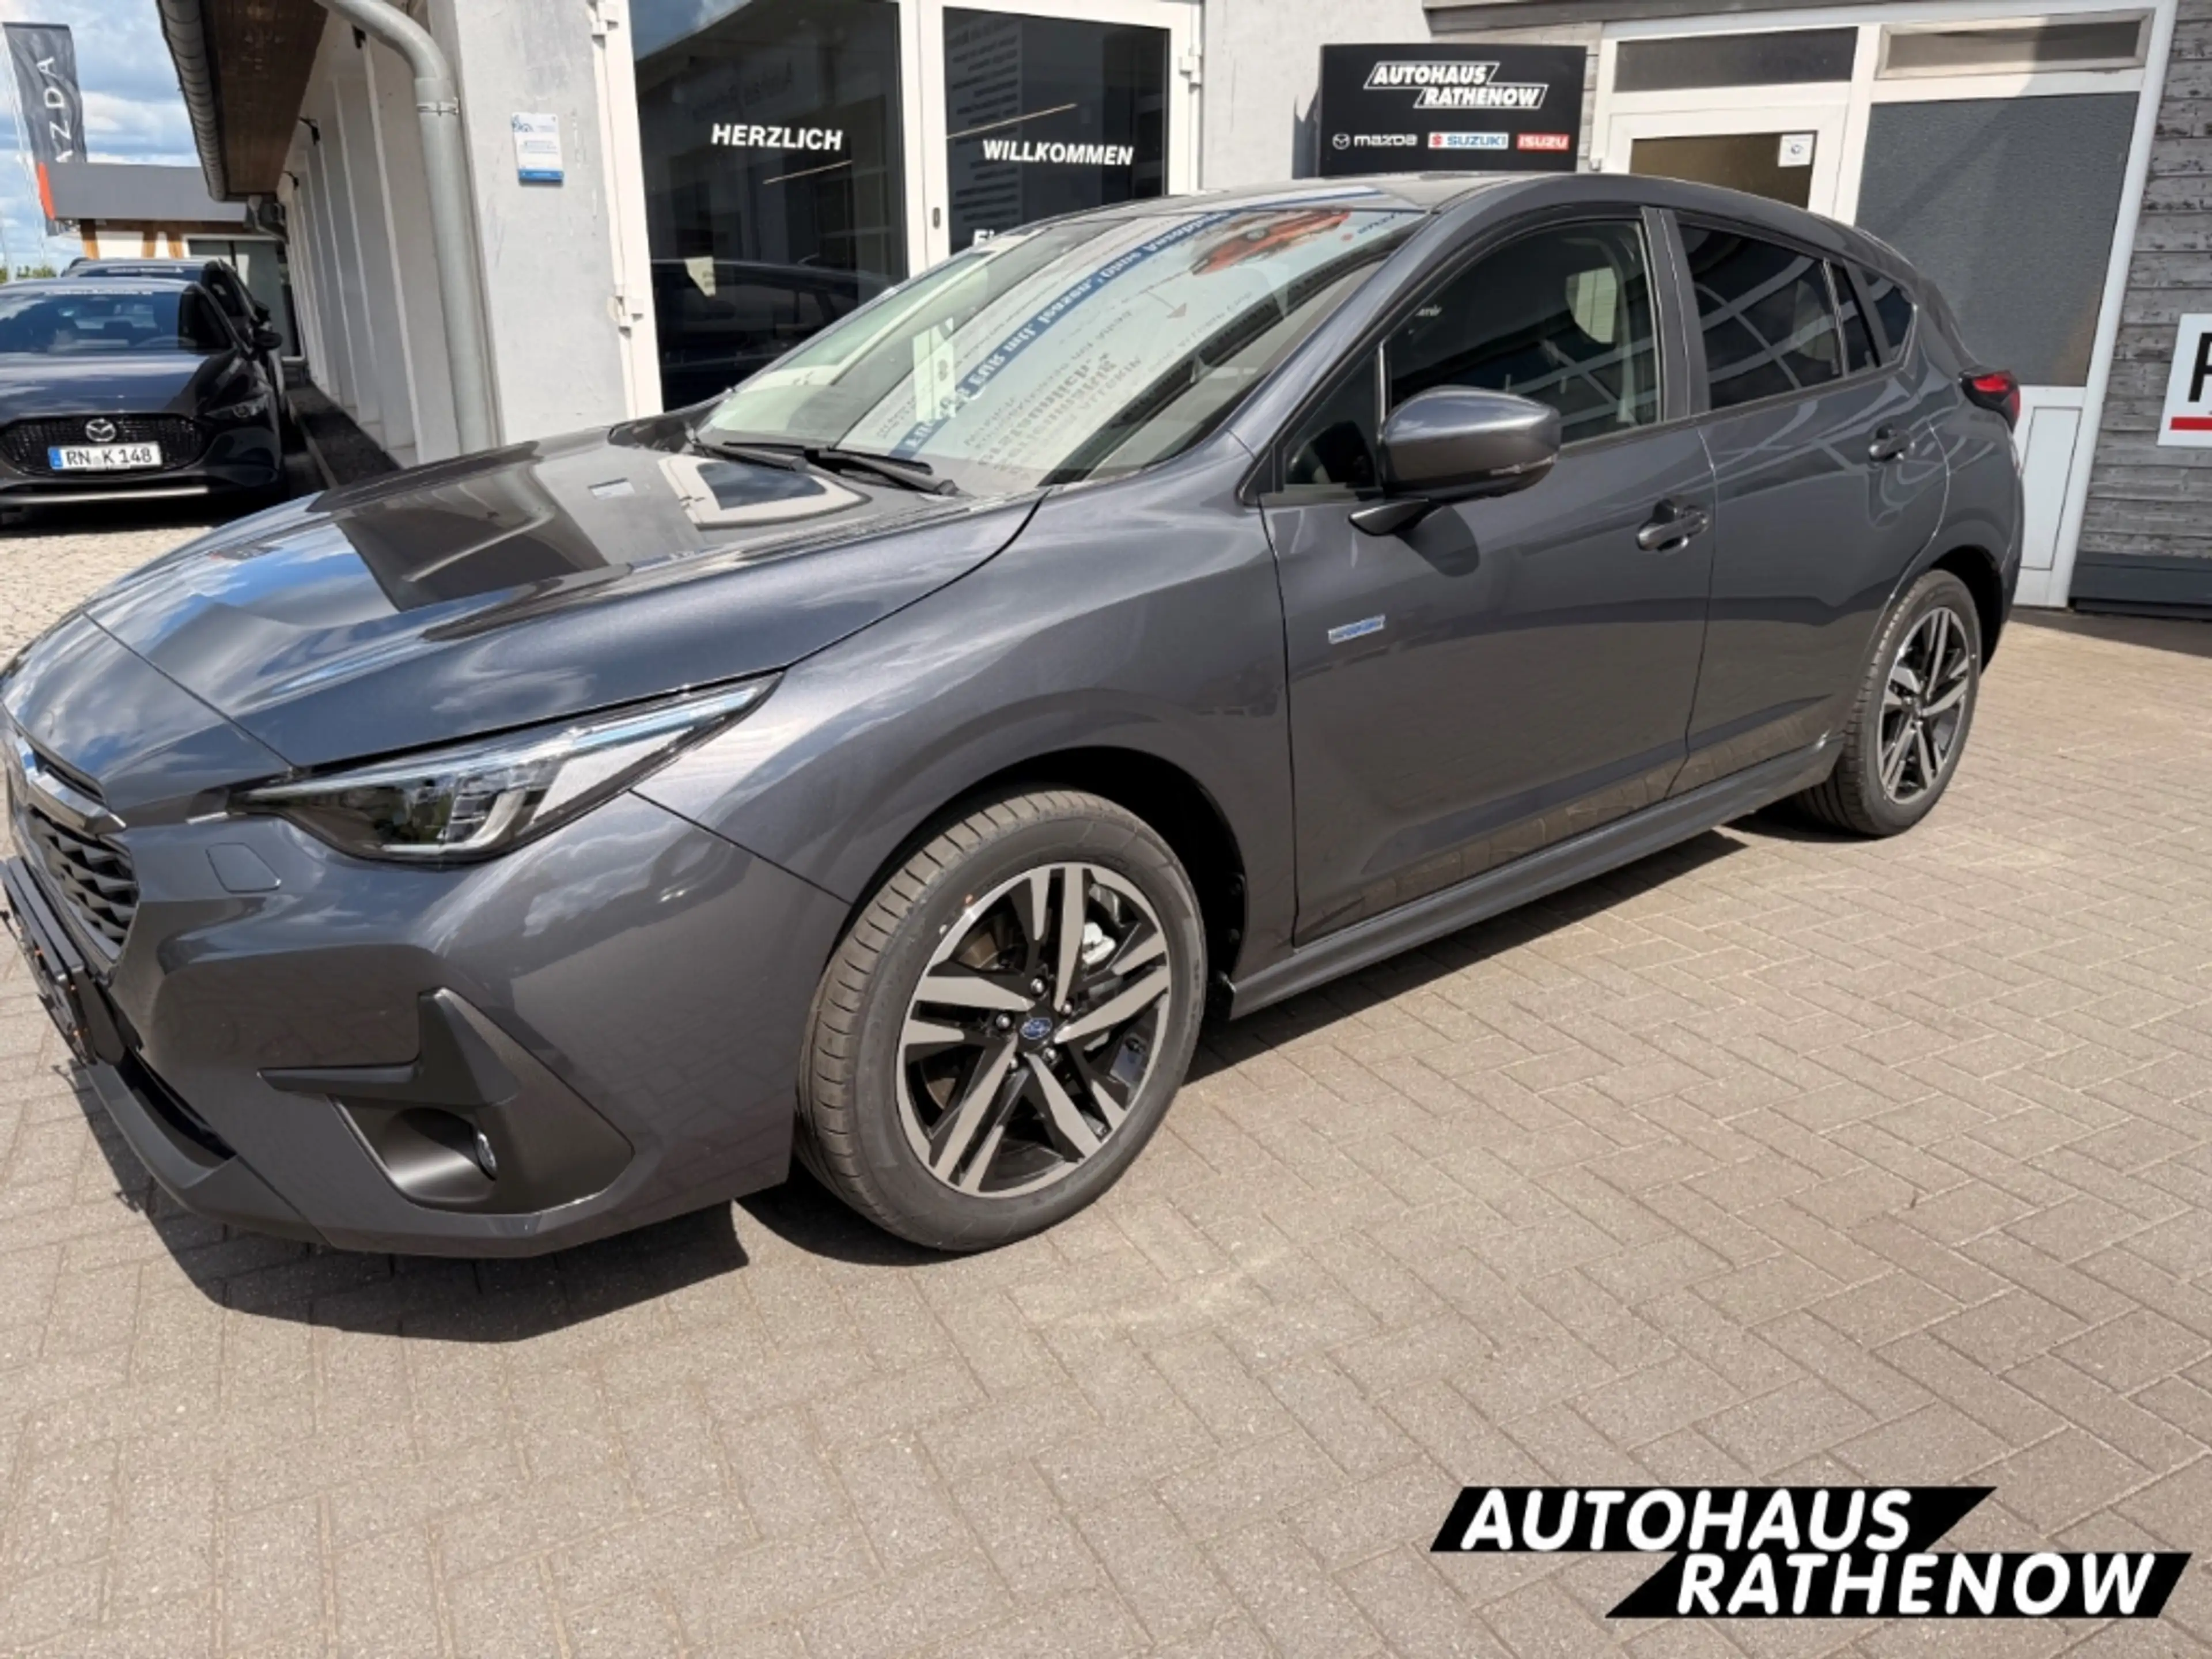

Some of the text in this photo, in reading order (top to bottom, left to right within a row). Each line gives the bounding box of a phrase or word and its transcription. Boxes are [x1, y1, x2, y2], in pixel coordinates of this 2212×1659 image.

[1373, 66, 1488, 85] AUTOHAUS
[1423, 87, 1540, 107] RATHENOW
[36, 56, 73, 163] AZDA
[711, 123, 843, 151] HERZLICH
[1354, 134, 1418, 146] mazda
[1447, 135, 1506, 147] SUZUKI
[1518, 136, 1568, 149] ISUZU
[983, 139, 1134, 166] WILLKOMMEN
[66, 447, 152, 465] RN K 148
